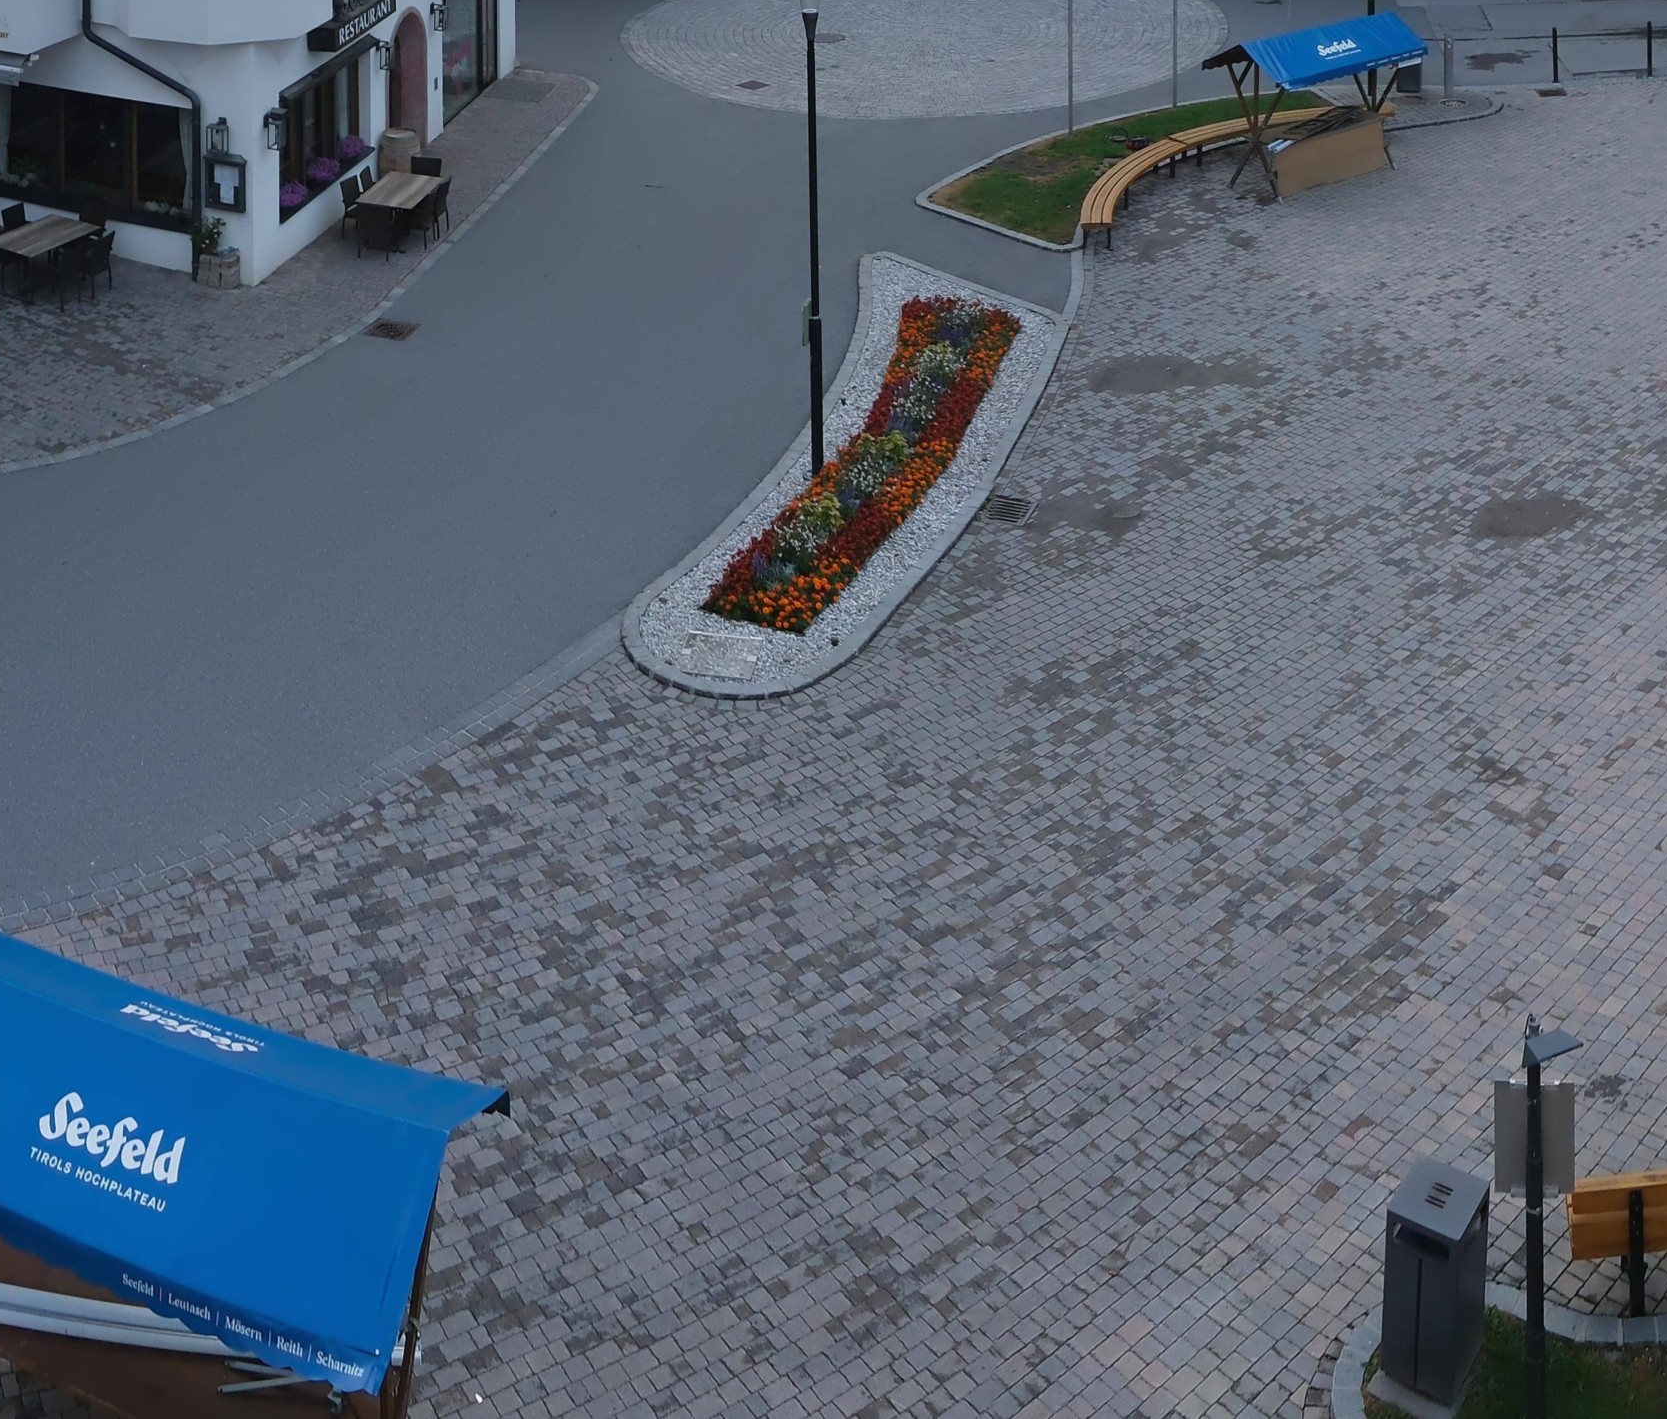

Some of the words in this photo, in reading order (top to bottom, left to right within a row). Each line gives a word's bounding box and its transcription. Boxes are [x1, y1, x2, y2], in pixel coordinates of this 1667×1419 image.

[1317, 39, 1357, 57] Seefeld
[119, 1003, 259, 1052] Seefeld
[38, 1091, 186, 1184] Seefeld
[30, 1146, 72, 1174] TIROLS
[75, 1166, 166, 1213] HOCHPLATEAU
[122, 1273, 154, 1297] Seefeld
[168, 1292, 211, 1321] Leutasch
[225, 1315, 262, 1343] Mösern
[276, 1335, 304, 1357] Reith
[316, 1350, 365, 1378] Scharnitz
